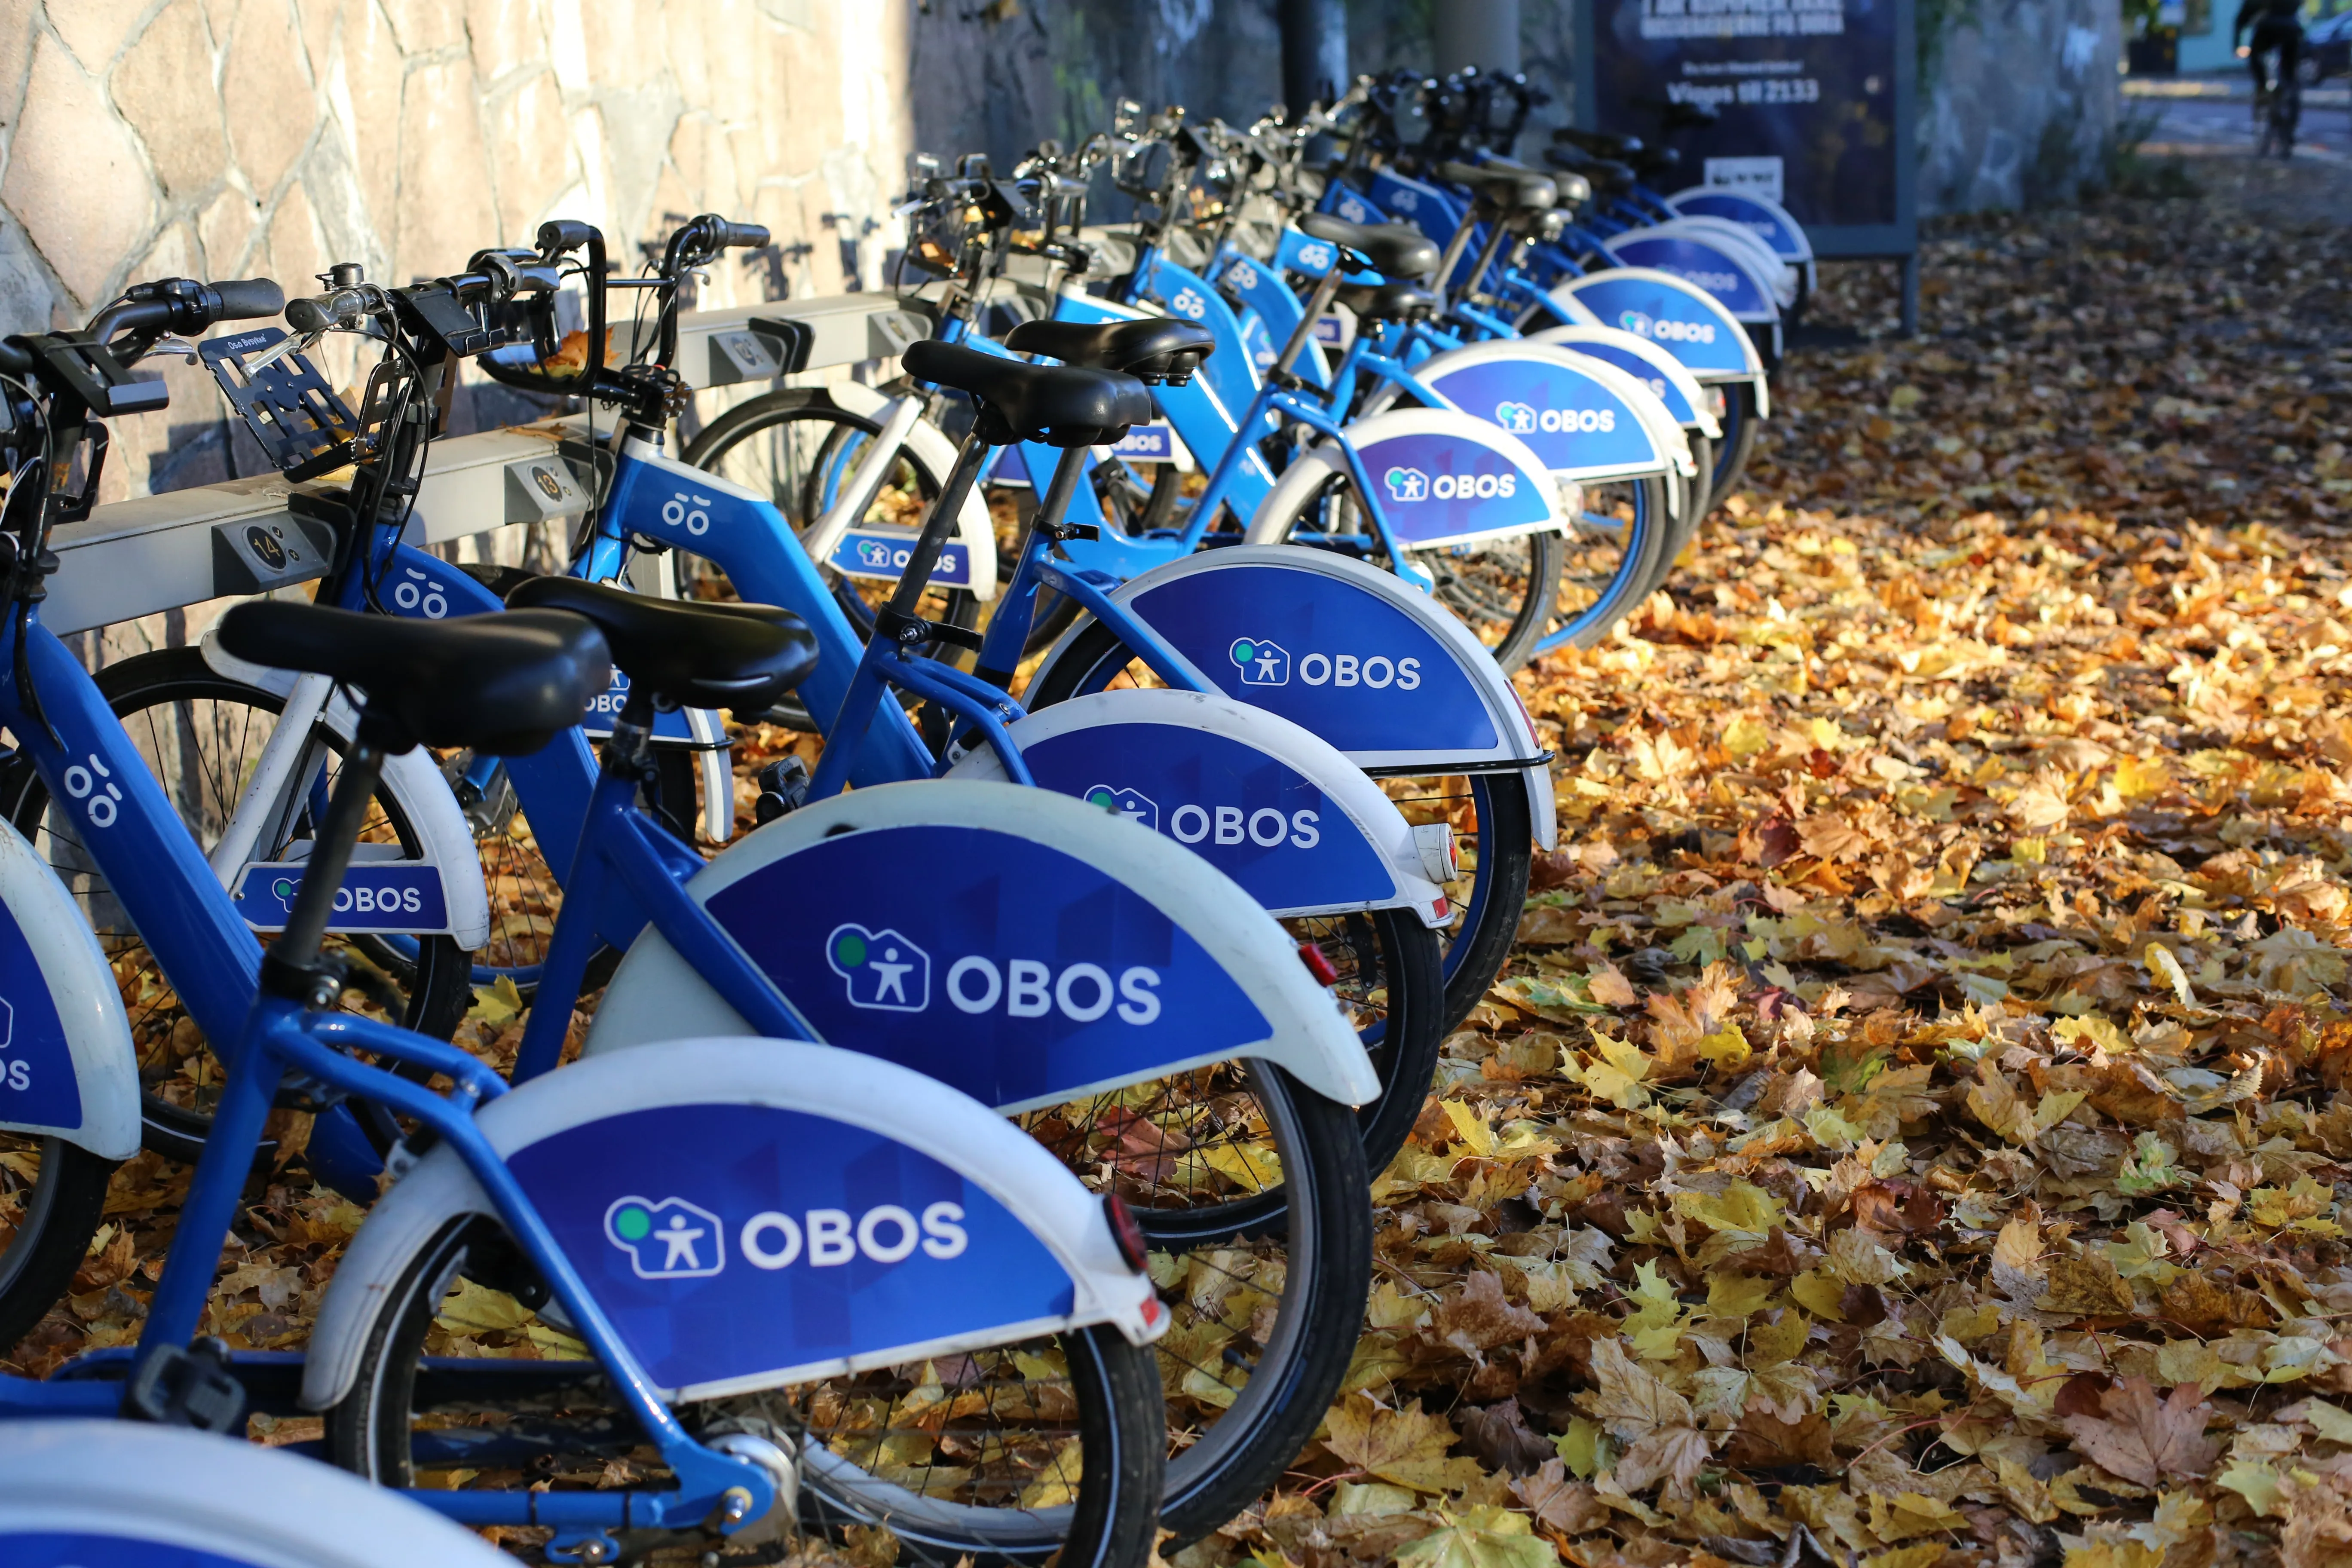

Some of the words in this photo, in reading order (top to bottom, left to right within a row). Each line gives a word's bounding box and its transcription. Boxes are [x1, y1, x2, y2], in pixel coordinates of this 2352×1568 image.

[1654, 319, 1715, 344] OBOS
[1540, 409, 1615, 432] OBOS
[537, 475, 558, 494] 13
[1433, 473, 1516, 499] OBOS
[254, 536, 280, 559] 14
[1299, 653, 1421, 690] OBOS
[584, 694, 628, 712] OBO
[1171, 804, 1320, 849] OBOS
[331, 887, 421, 912] OBOS
[946, 956, 1161, 1026] OBOS
[741, 1202, 968, 1270] OBOS
